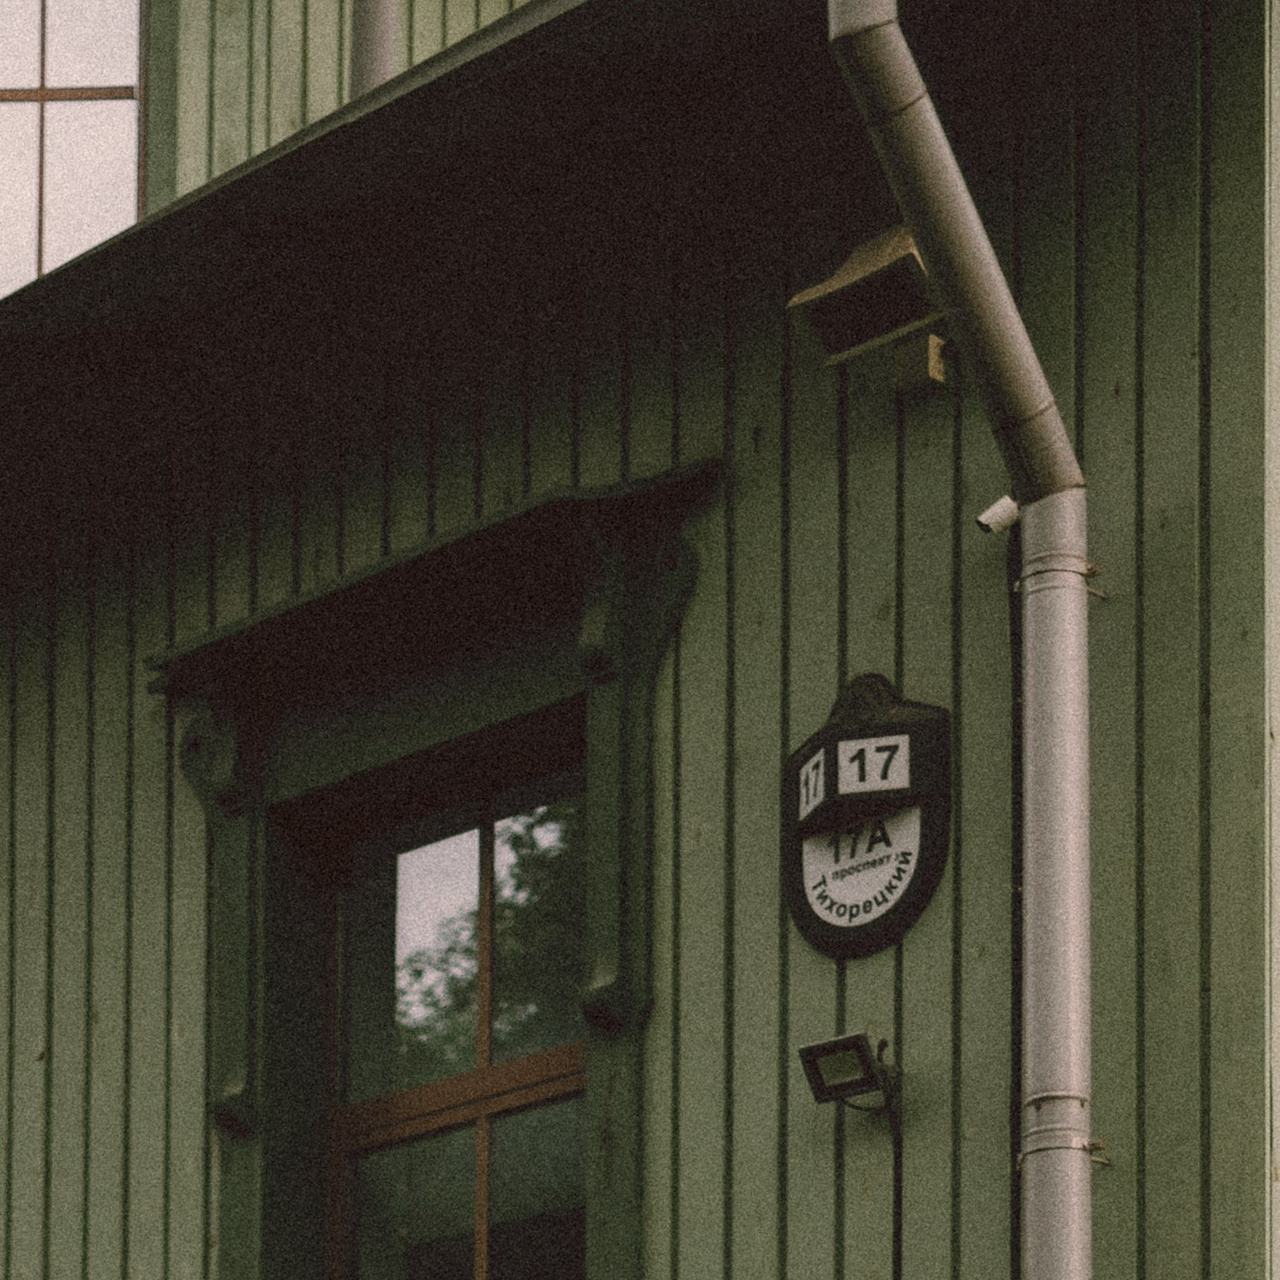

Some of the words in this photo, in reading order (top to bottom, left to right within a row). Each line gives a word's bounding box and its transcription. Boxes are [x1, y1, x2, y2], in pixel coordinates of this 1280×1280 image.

[804, 759, 821, 806] 17
[849, 744, 900, 783] 17
[827, 819, 893, 865] 17А
[812, 850, 913, 924] Тихорецкий
[832, 853, 892, 881] проспект
